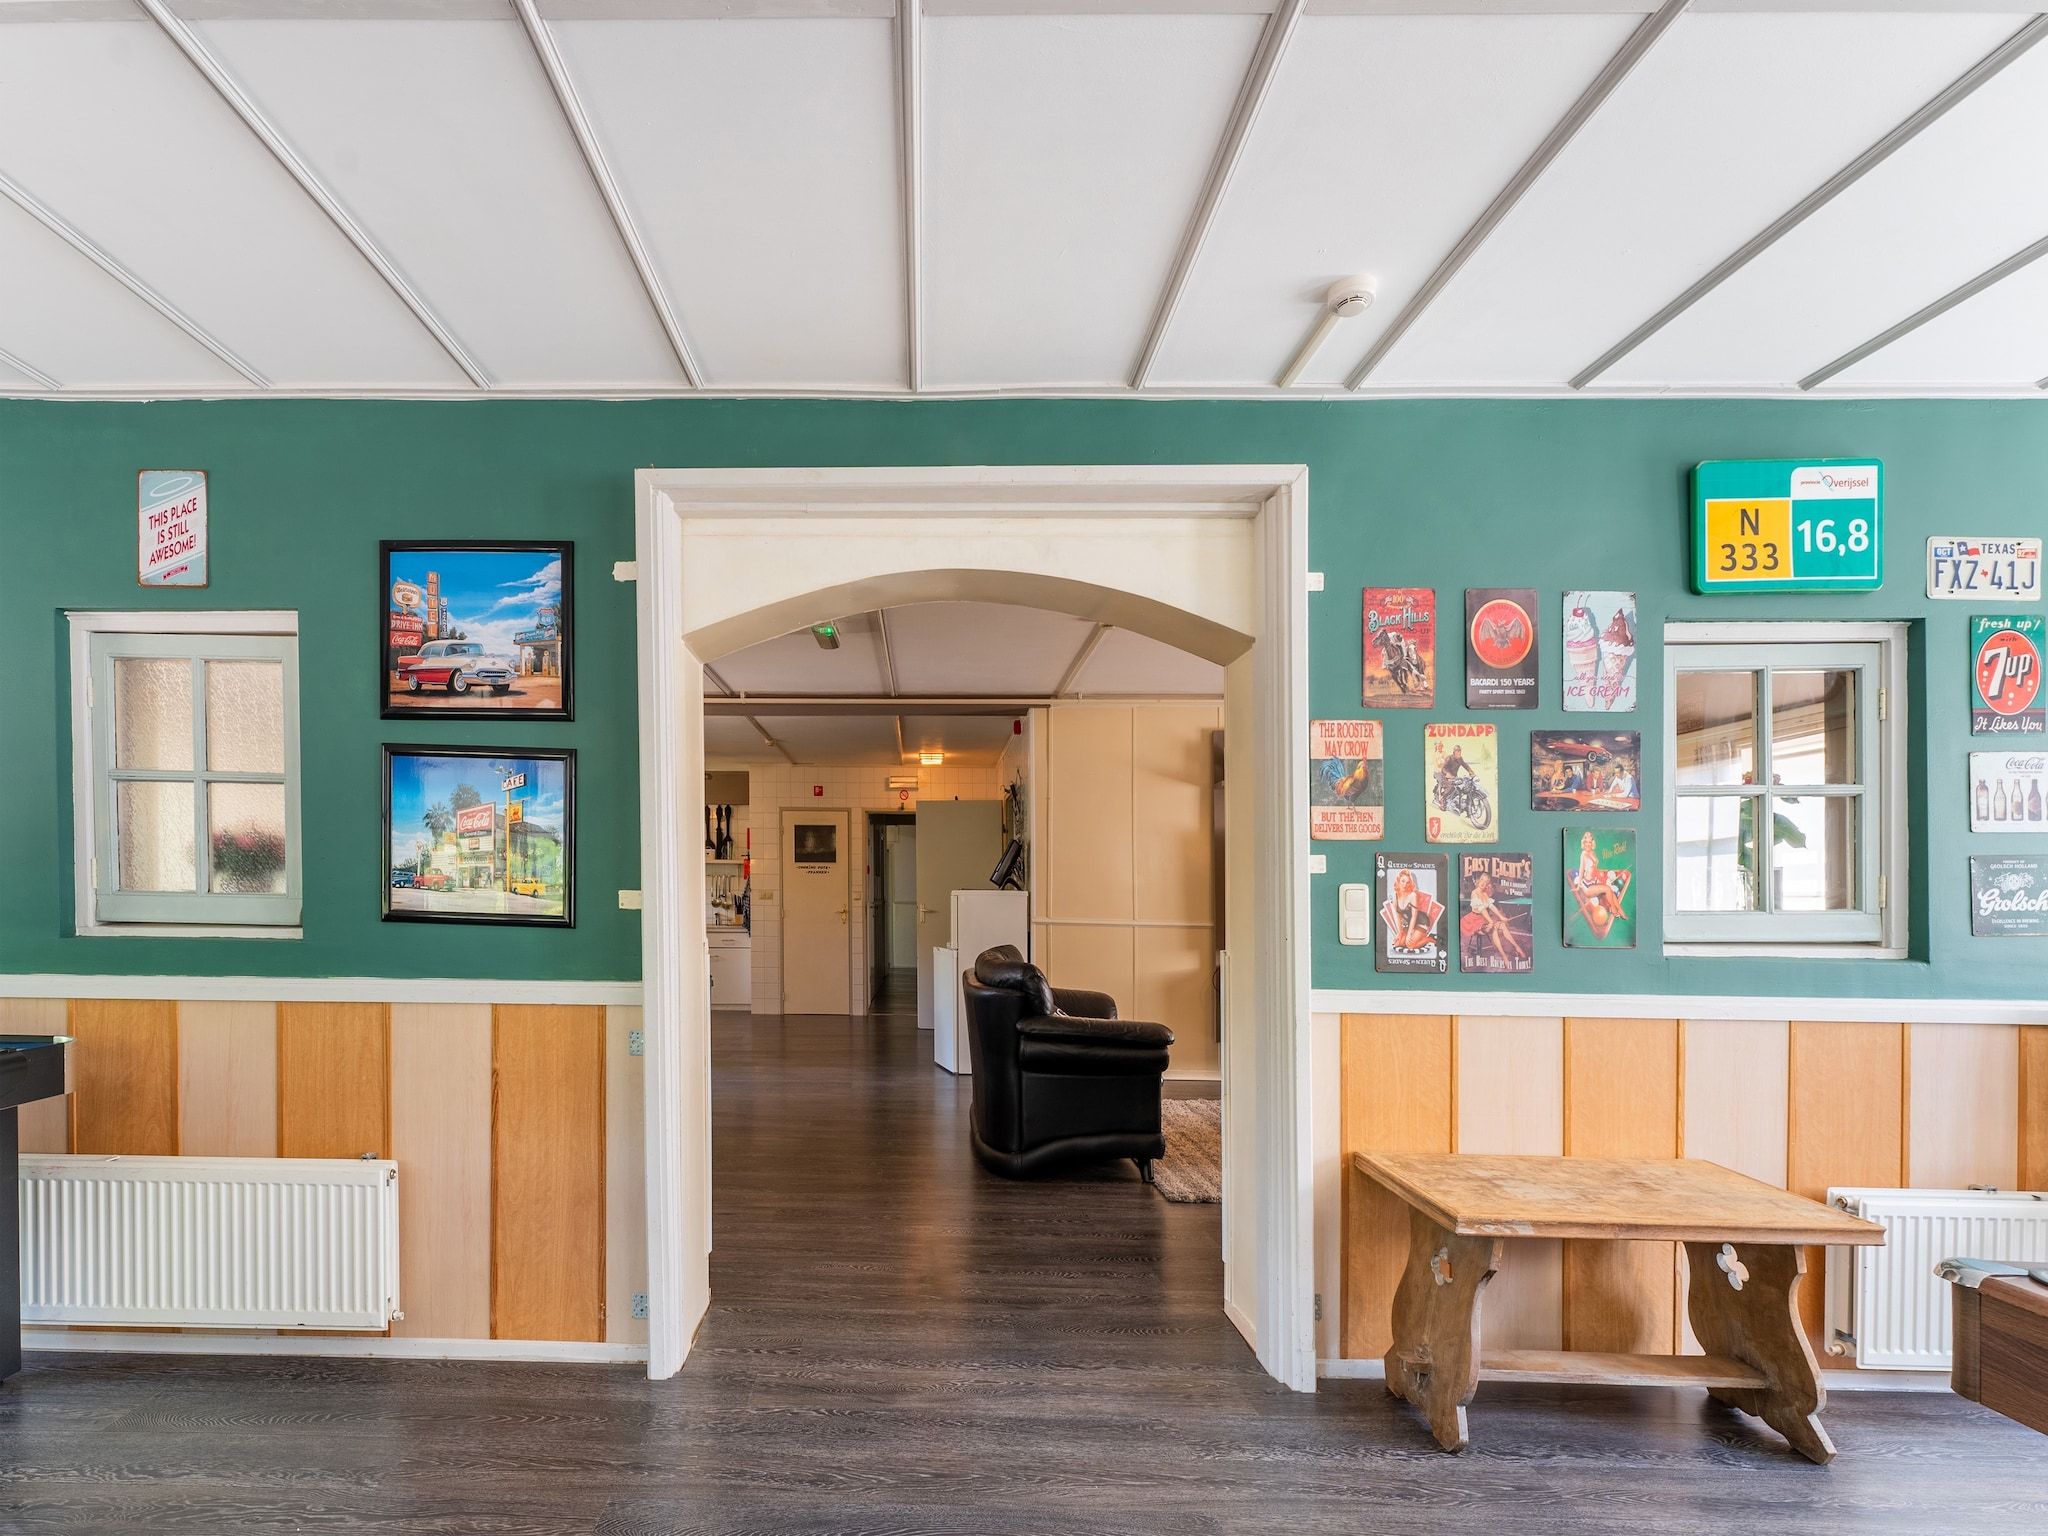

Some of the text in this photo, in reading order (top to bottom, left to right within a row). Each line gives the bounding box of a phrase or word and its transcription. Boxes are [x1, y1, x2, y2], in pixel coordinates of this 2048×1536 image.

[1821, 474, 1869, 490] Overijssel
[149, 497, 198, 530] THIS PLACE
[1740, 508, 1760, 536] N
[157, 519, 190, 545] IS STILL
[1797, 518, 1869, 557] 16,8
[149, 533, 197, 567] AWESOME!
[1720, 542, 1779, 571] 333
[1936, 548, 1951, 556] OCT
[1981, 543, 2016, 555] TEXAS
[1934, 559, 2036, 590] FXZ 41J
[1368, 606, 1430, 634] BLACK HILLS
[1977, 618, 2011, 633] fresh
[1470, 678, 1535, 687] BACARDI 150 YEARS
[1566, 685, 1631, 698] ICE CREAM
[1319, 722, 1374, 738] THE ROOSTER
[1975, 716, 2043, 735] It Likes You
[1324, 741, 1369, 756] MAY CROW
[502, 774, 524, 790] CAFE
[1321, 812, 1374, 823] BUT THE HEN
[1314, 823, 1381, 833] DELIVERS THE GOODS
[1377, 855, 1385, 868] Q
[1387, 860, 1408, 869] QUEEN
[1977, 888, 2048, 917] Grolsch
